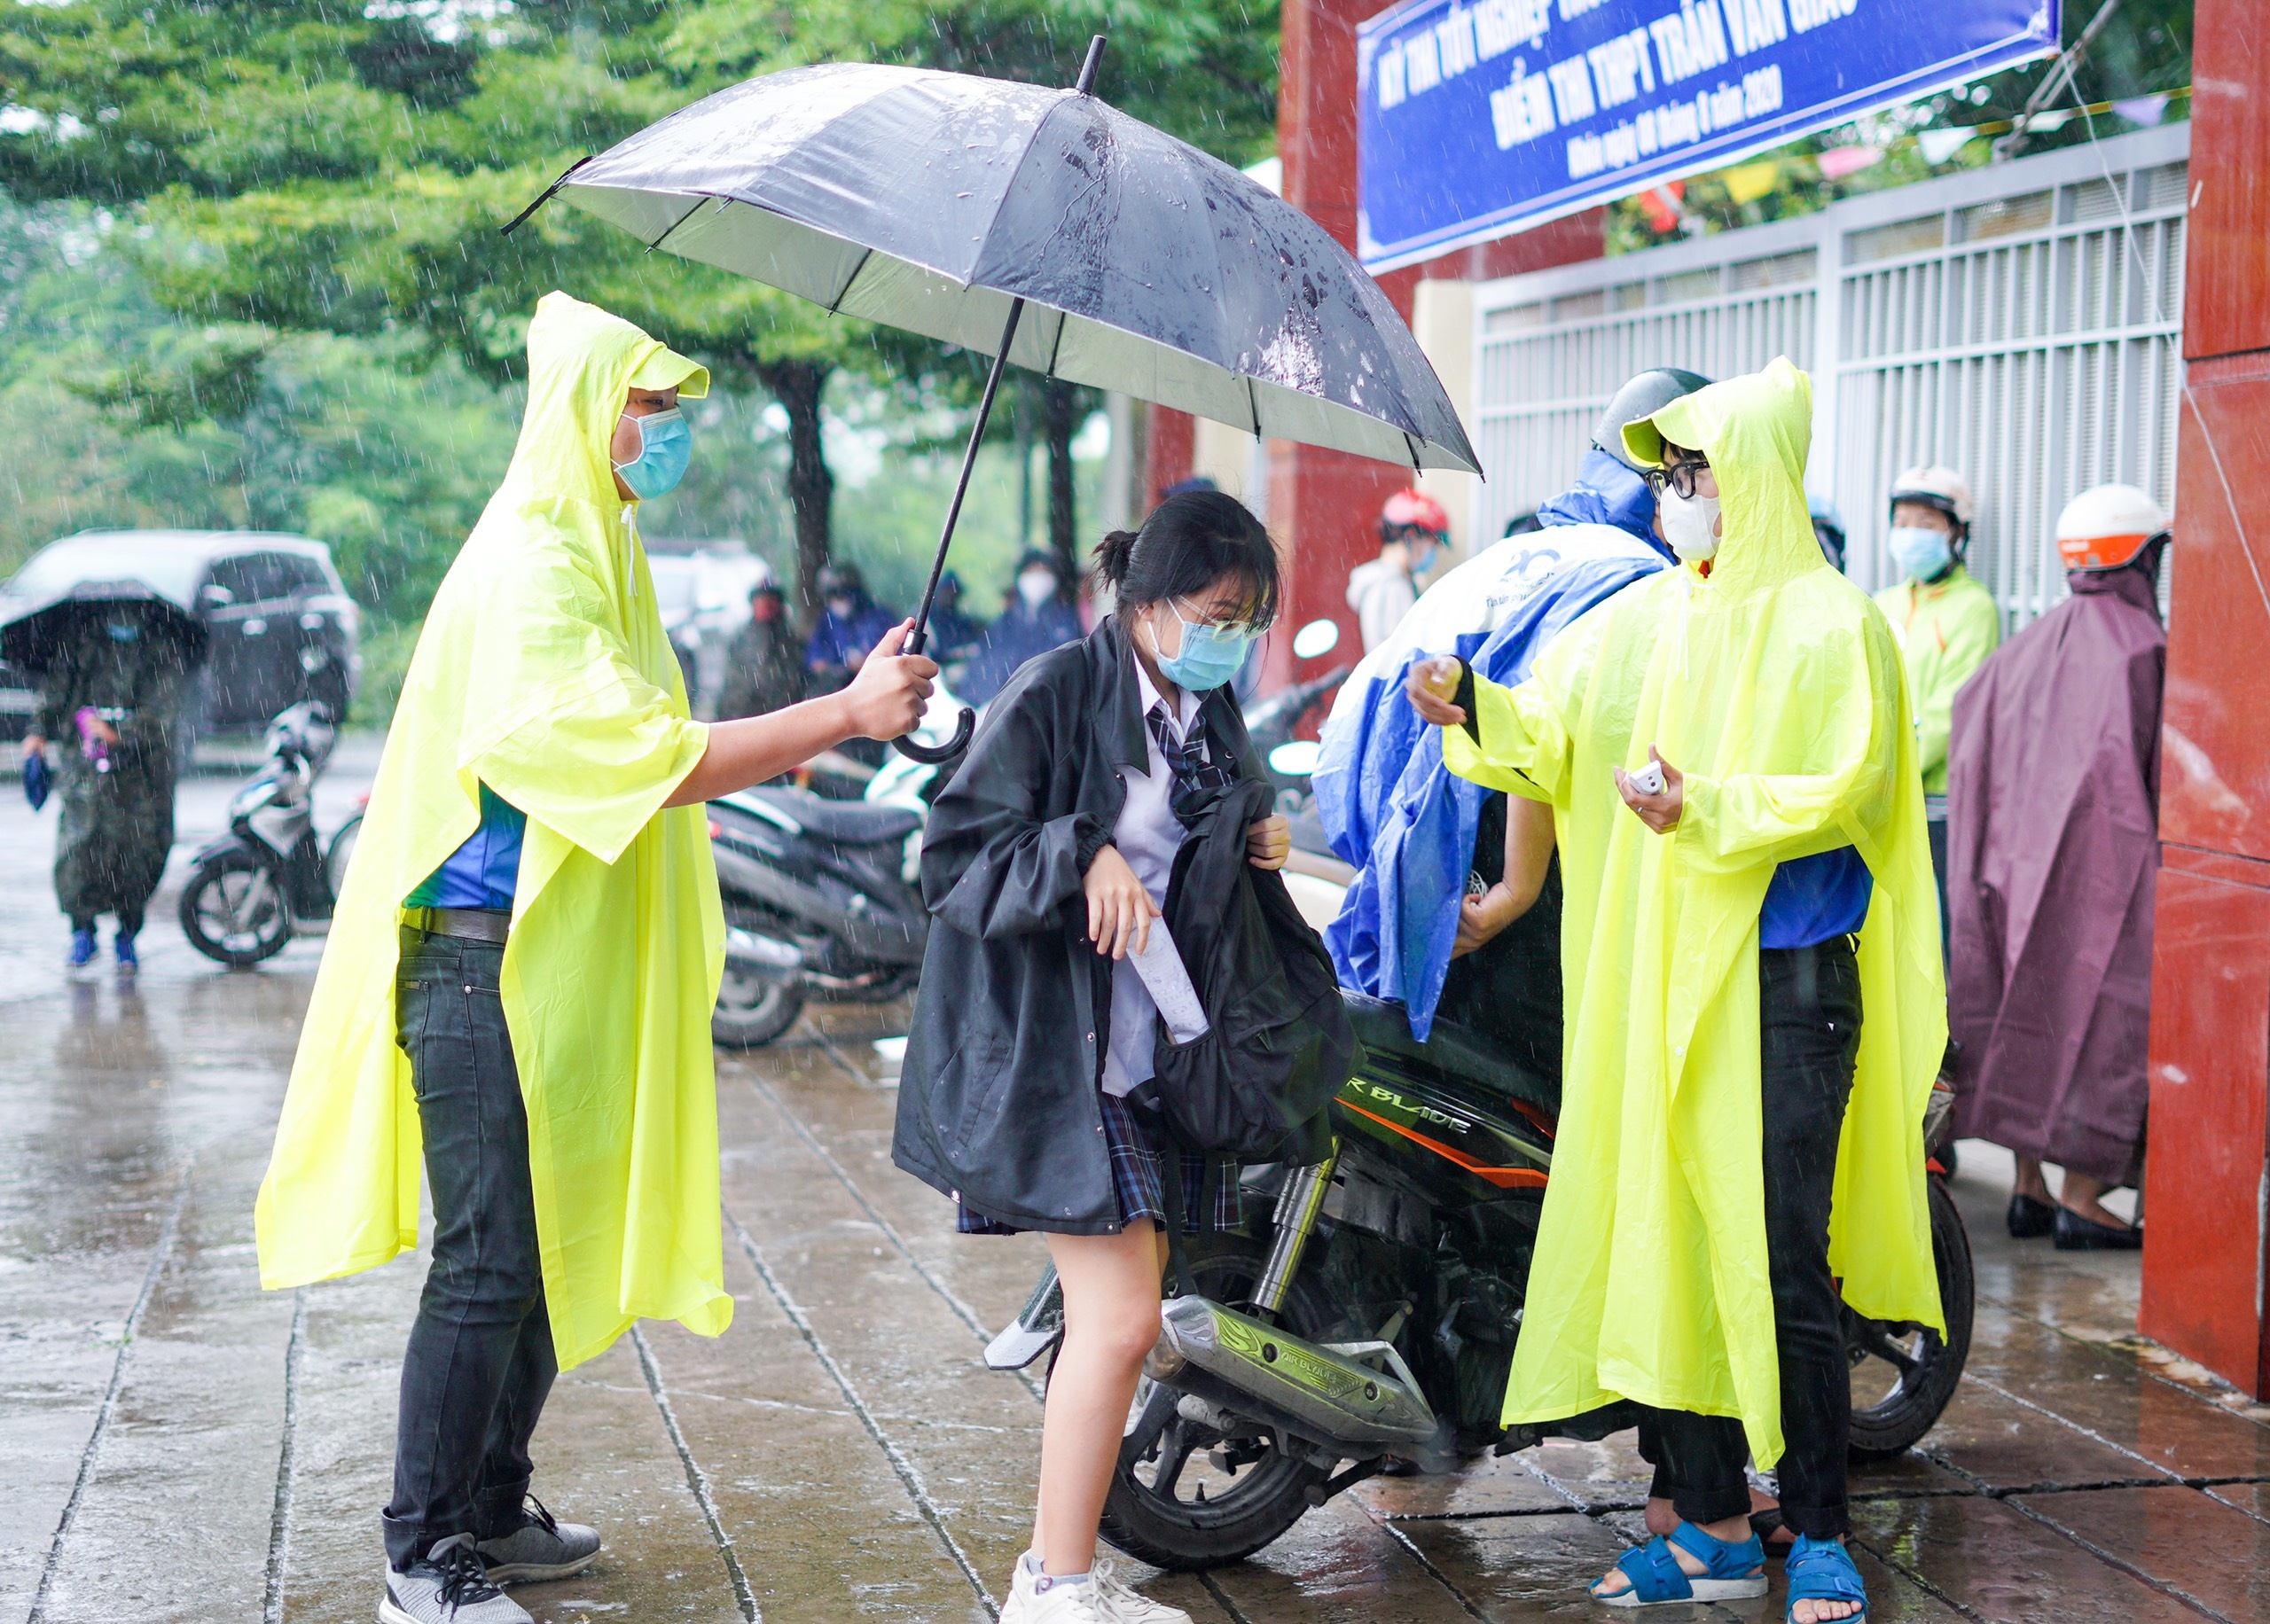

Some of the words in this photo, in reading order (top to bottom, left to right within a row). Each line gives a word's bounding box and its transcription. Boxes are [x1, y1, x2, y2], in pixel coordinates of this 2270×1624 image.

[1405, 29, 1441, 97] THI
[1546, 53, 1596, 126] THI
[1586, 26, 1656, 111] THPT
[1742, 64, 1784, 119] 2020
[1369, 1085, 1472, 1135] BLADE
[1280, 1350, 1299, 1366] AIR
